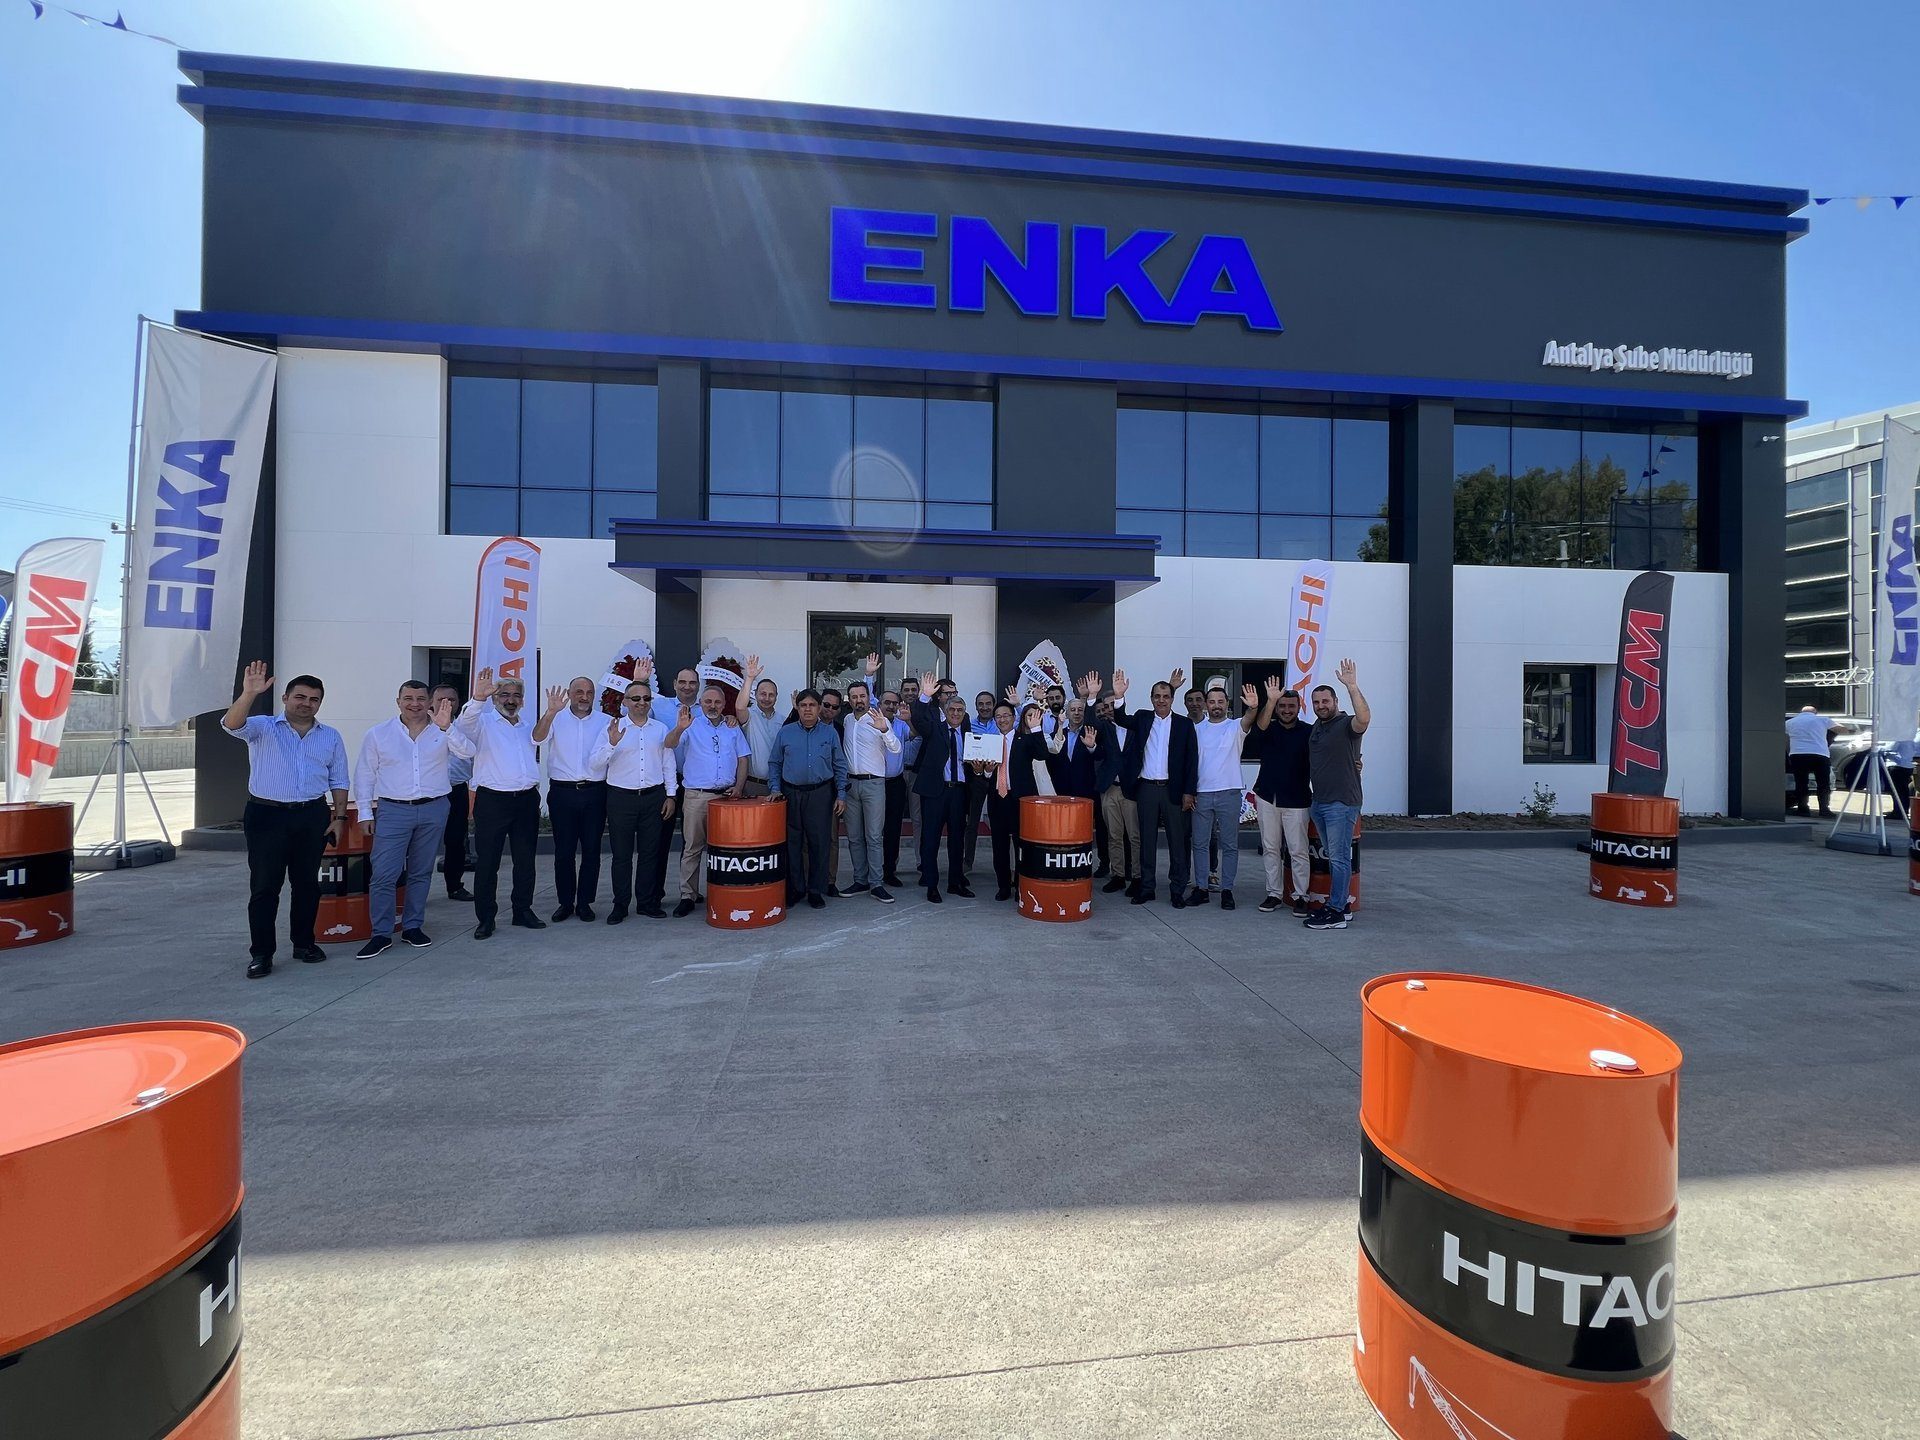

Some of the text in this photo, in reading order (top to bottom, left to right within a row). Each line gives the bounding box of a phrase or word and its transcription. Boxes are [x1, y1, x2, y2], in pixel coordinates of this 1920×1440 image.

[830, 206, 1285, 333] ENKA
[1543, 340, 1753, 380] Antalya Şube Müdürlüğü
[144, 439, 236, 631] ENKA
[17, 573, 88, 779] TCM
[1614, 608, 1664, 776] TCM
[707, 853, 778, 873] HITACHI
[1591, 838, 1671, 860] HITACHI
